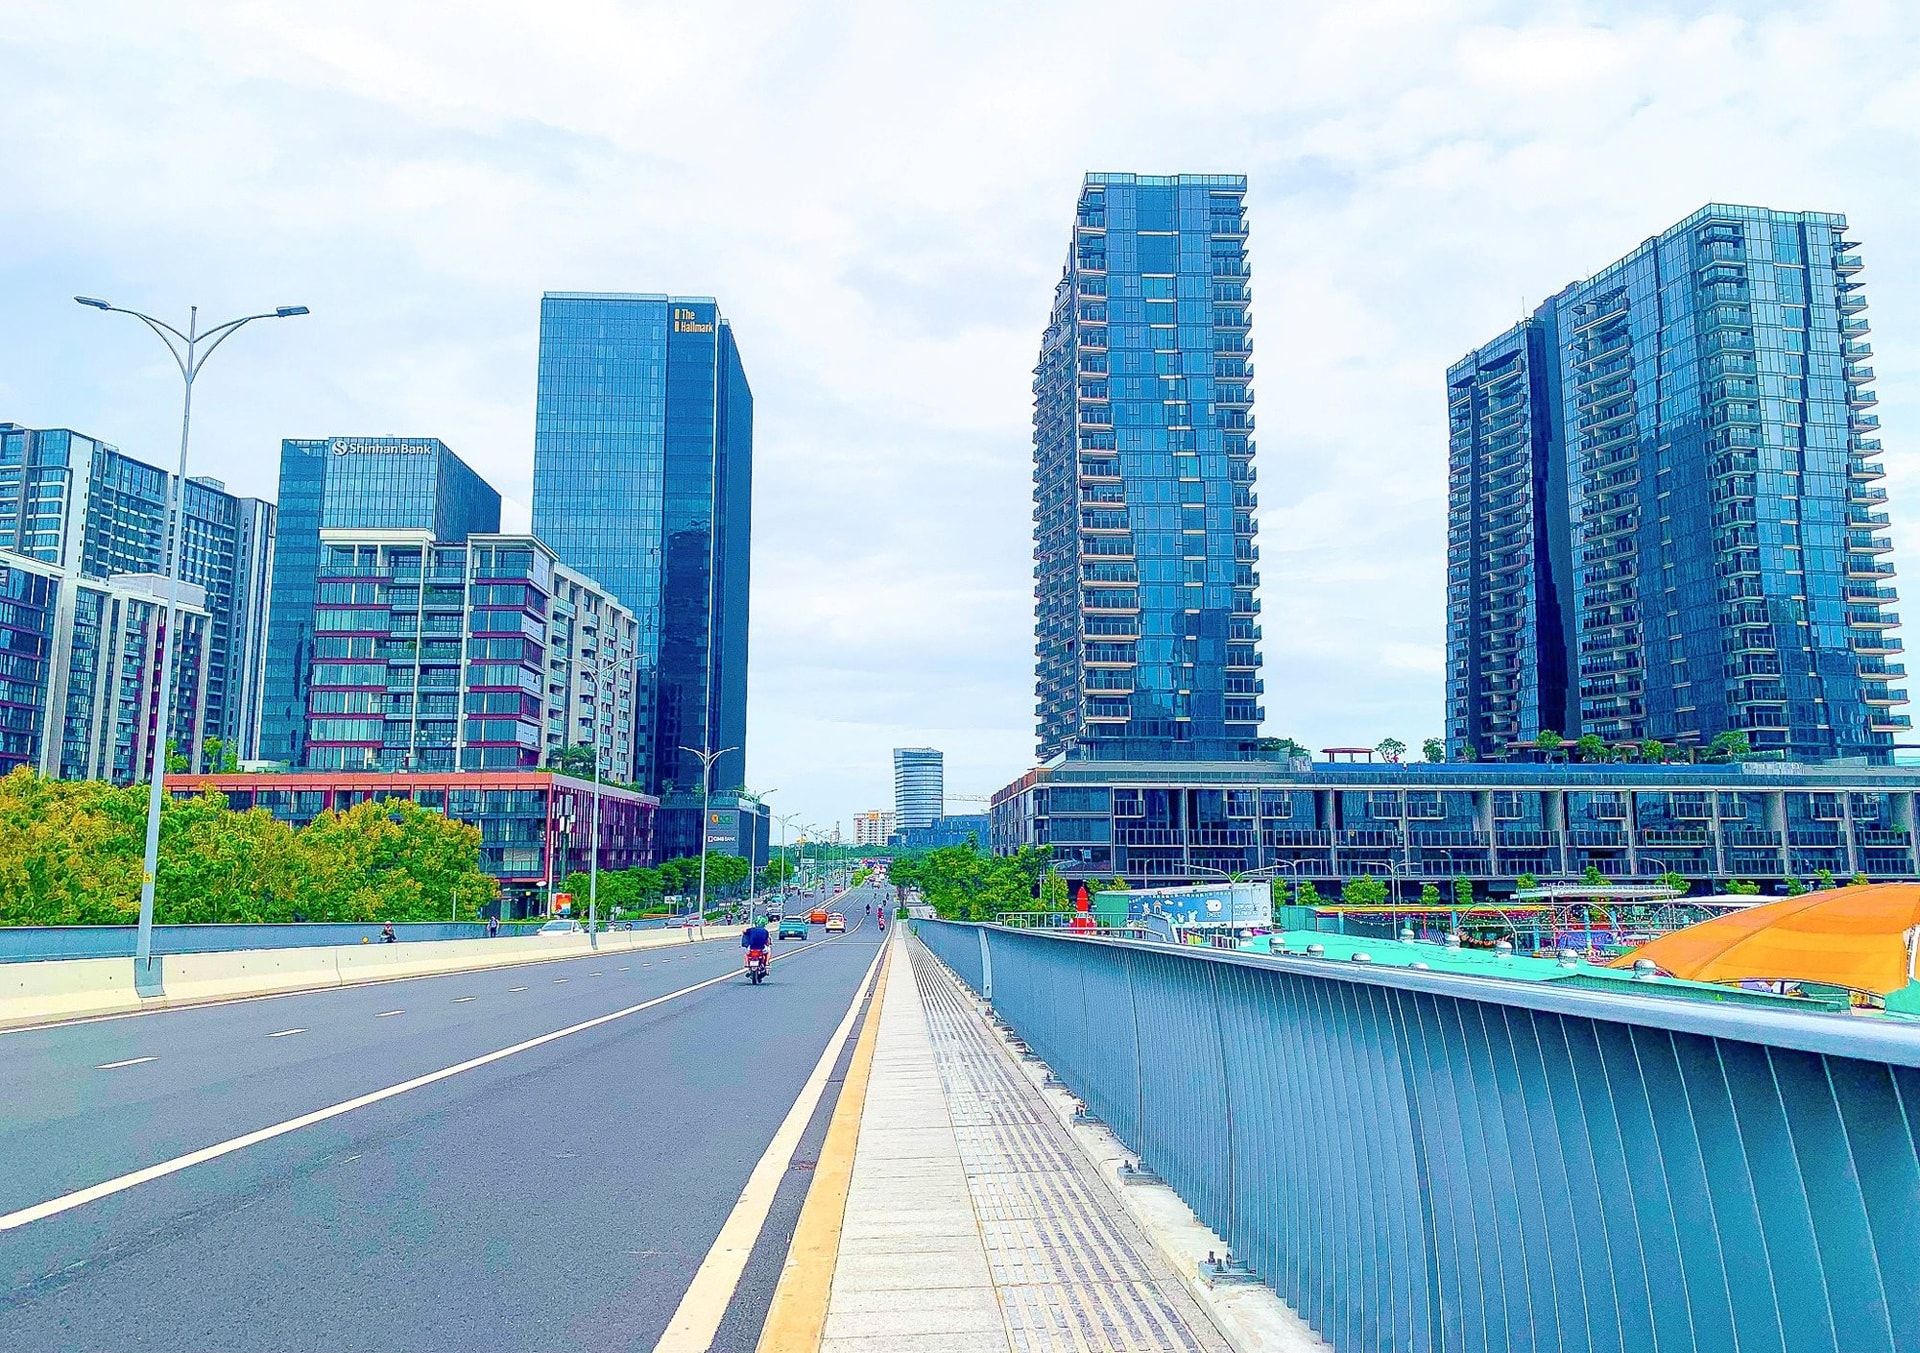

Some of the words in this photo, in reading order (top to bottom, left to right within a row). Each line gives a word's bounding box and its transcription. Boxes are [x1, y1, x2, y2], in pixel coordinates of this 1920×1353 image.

[682, 309, 695, 320] The
[681, 321, 713, 332] Hallmark
[349, 443, 398, 454] Shinhan
[401, 443, 431, 455] Bank
